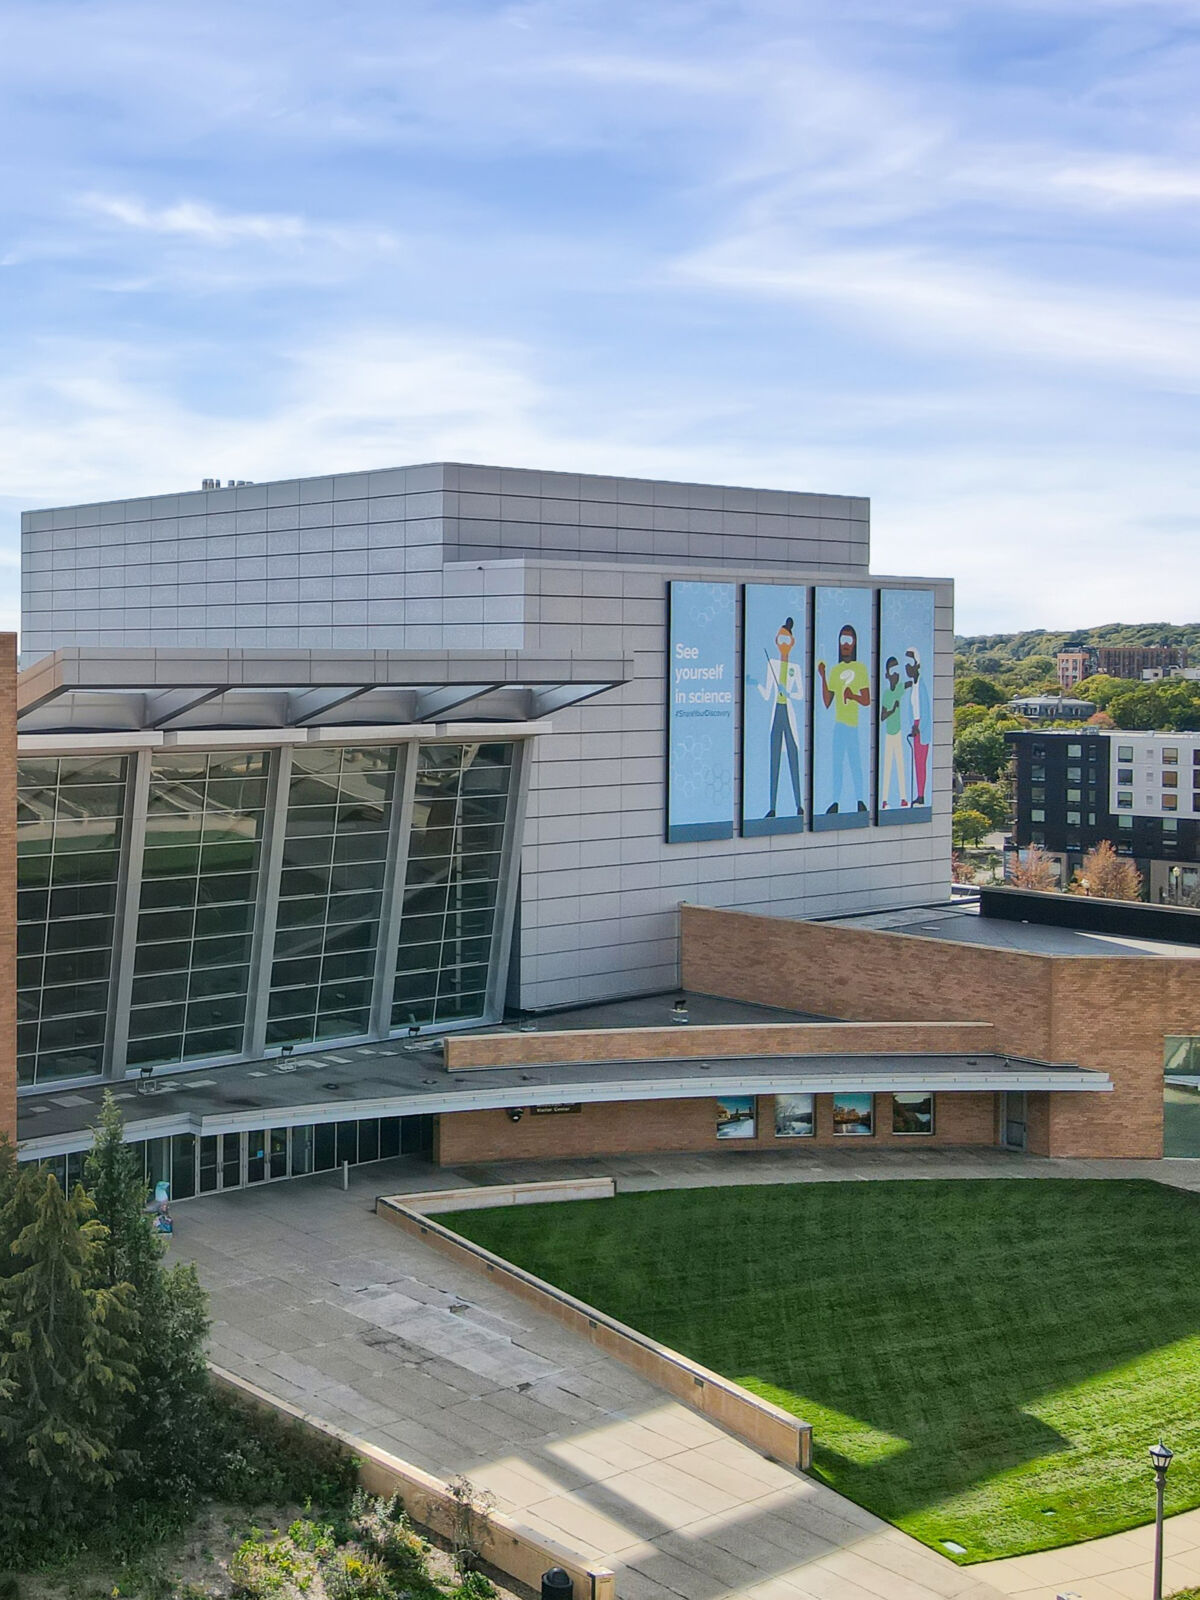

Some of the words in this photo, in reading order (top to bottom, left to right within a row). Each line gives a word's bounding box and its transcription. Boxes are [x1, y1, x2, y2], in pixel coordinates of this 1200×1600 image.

[675, 643, 699, 659] See
[675, 664, 725, 684] yourself
[675, 688, 686, 704] in
[688, 688, 732, 704] science
